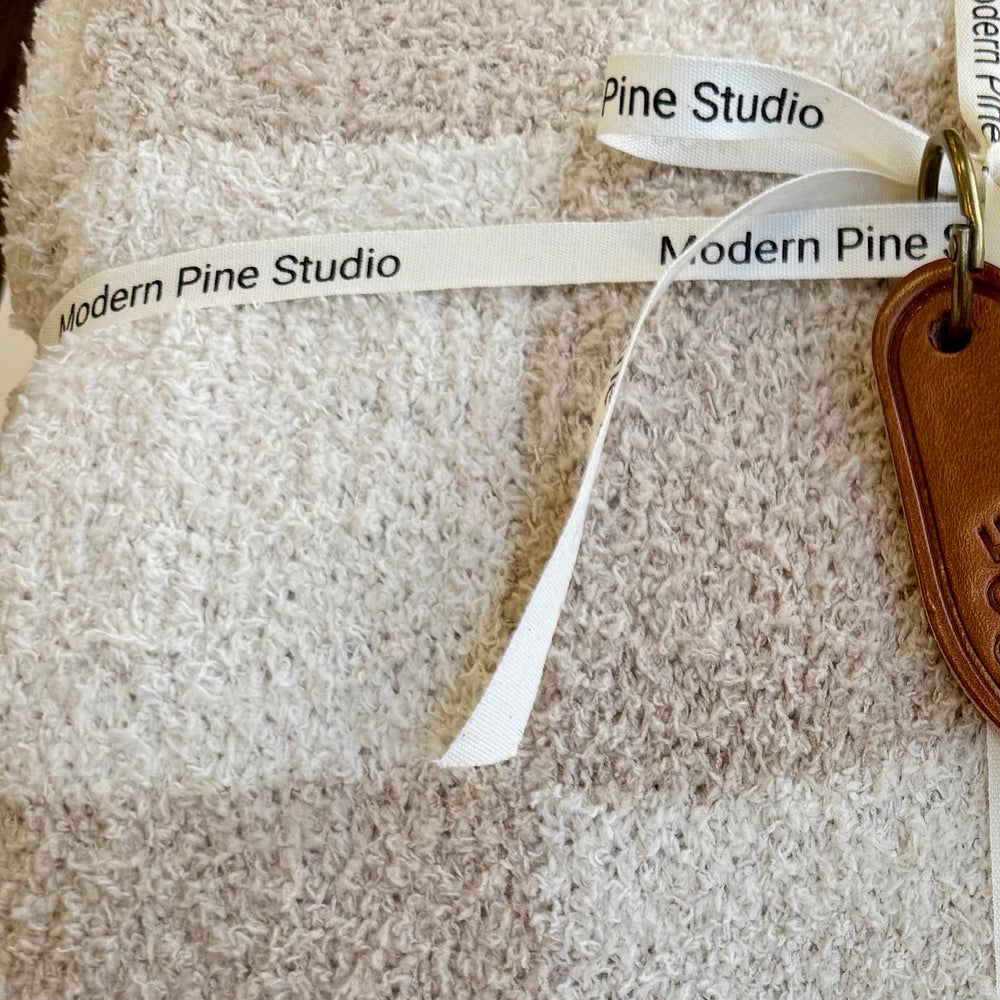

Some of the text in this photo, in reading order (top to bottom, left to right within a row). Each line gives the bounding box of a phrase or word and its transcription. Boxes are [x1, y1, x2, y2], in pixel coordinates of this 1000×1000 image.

[602, 76, 824, 129] Pine Studio
[660, 231, 820, 266] Modern
[837, 225, 928, 262] Pine
[59, 247, 401, 340] Modern Pine Studio
